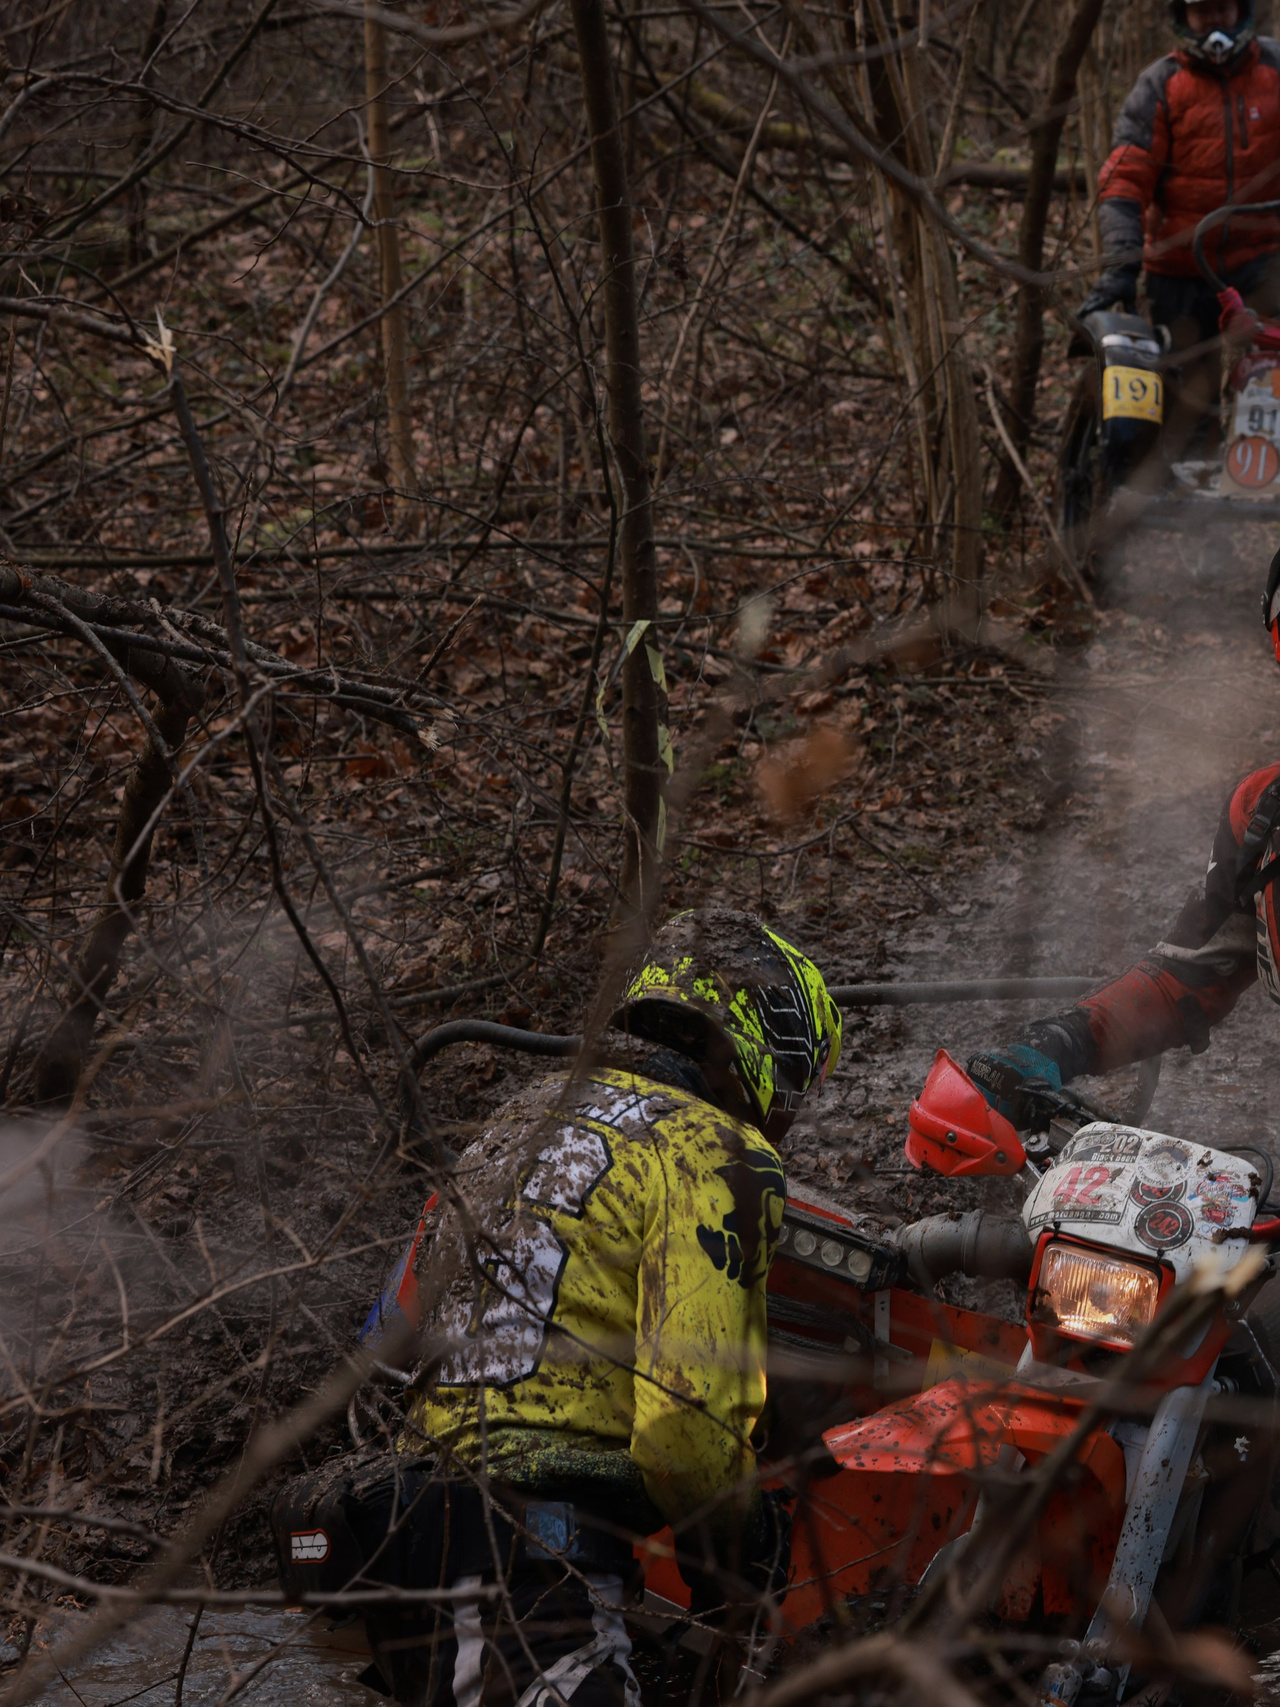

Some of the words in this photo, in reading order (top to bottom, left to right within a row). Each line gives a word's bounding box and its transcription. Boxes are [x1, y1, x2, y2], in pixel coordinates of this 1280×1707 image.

[1112, 376, 1161, 407] 191
[1248, 405, 1278, 435] 91
[1235, 441, 1268, 481] 91
[1053, 1166, 1110, 1205] 42
[1149, 1212, 1180, 1237] 242
